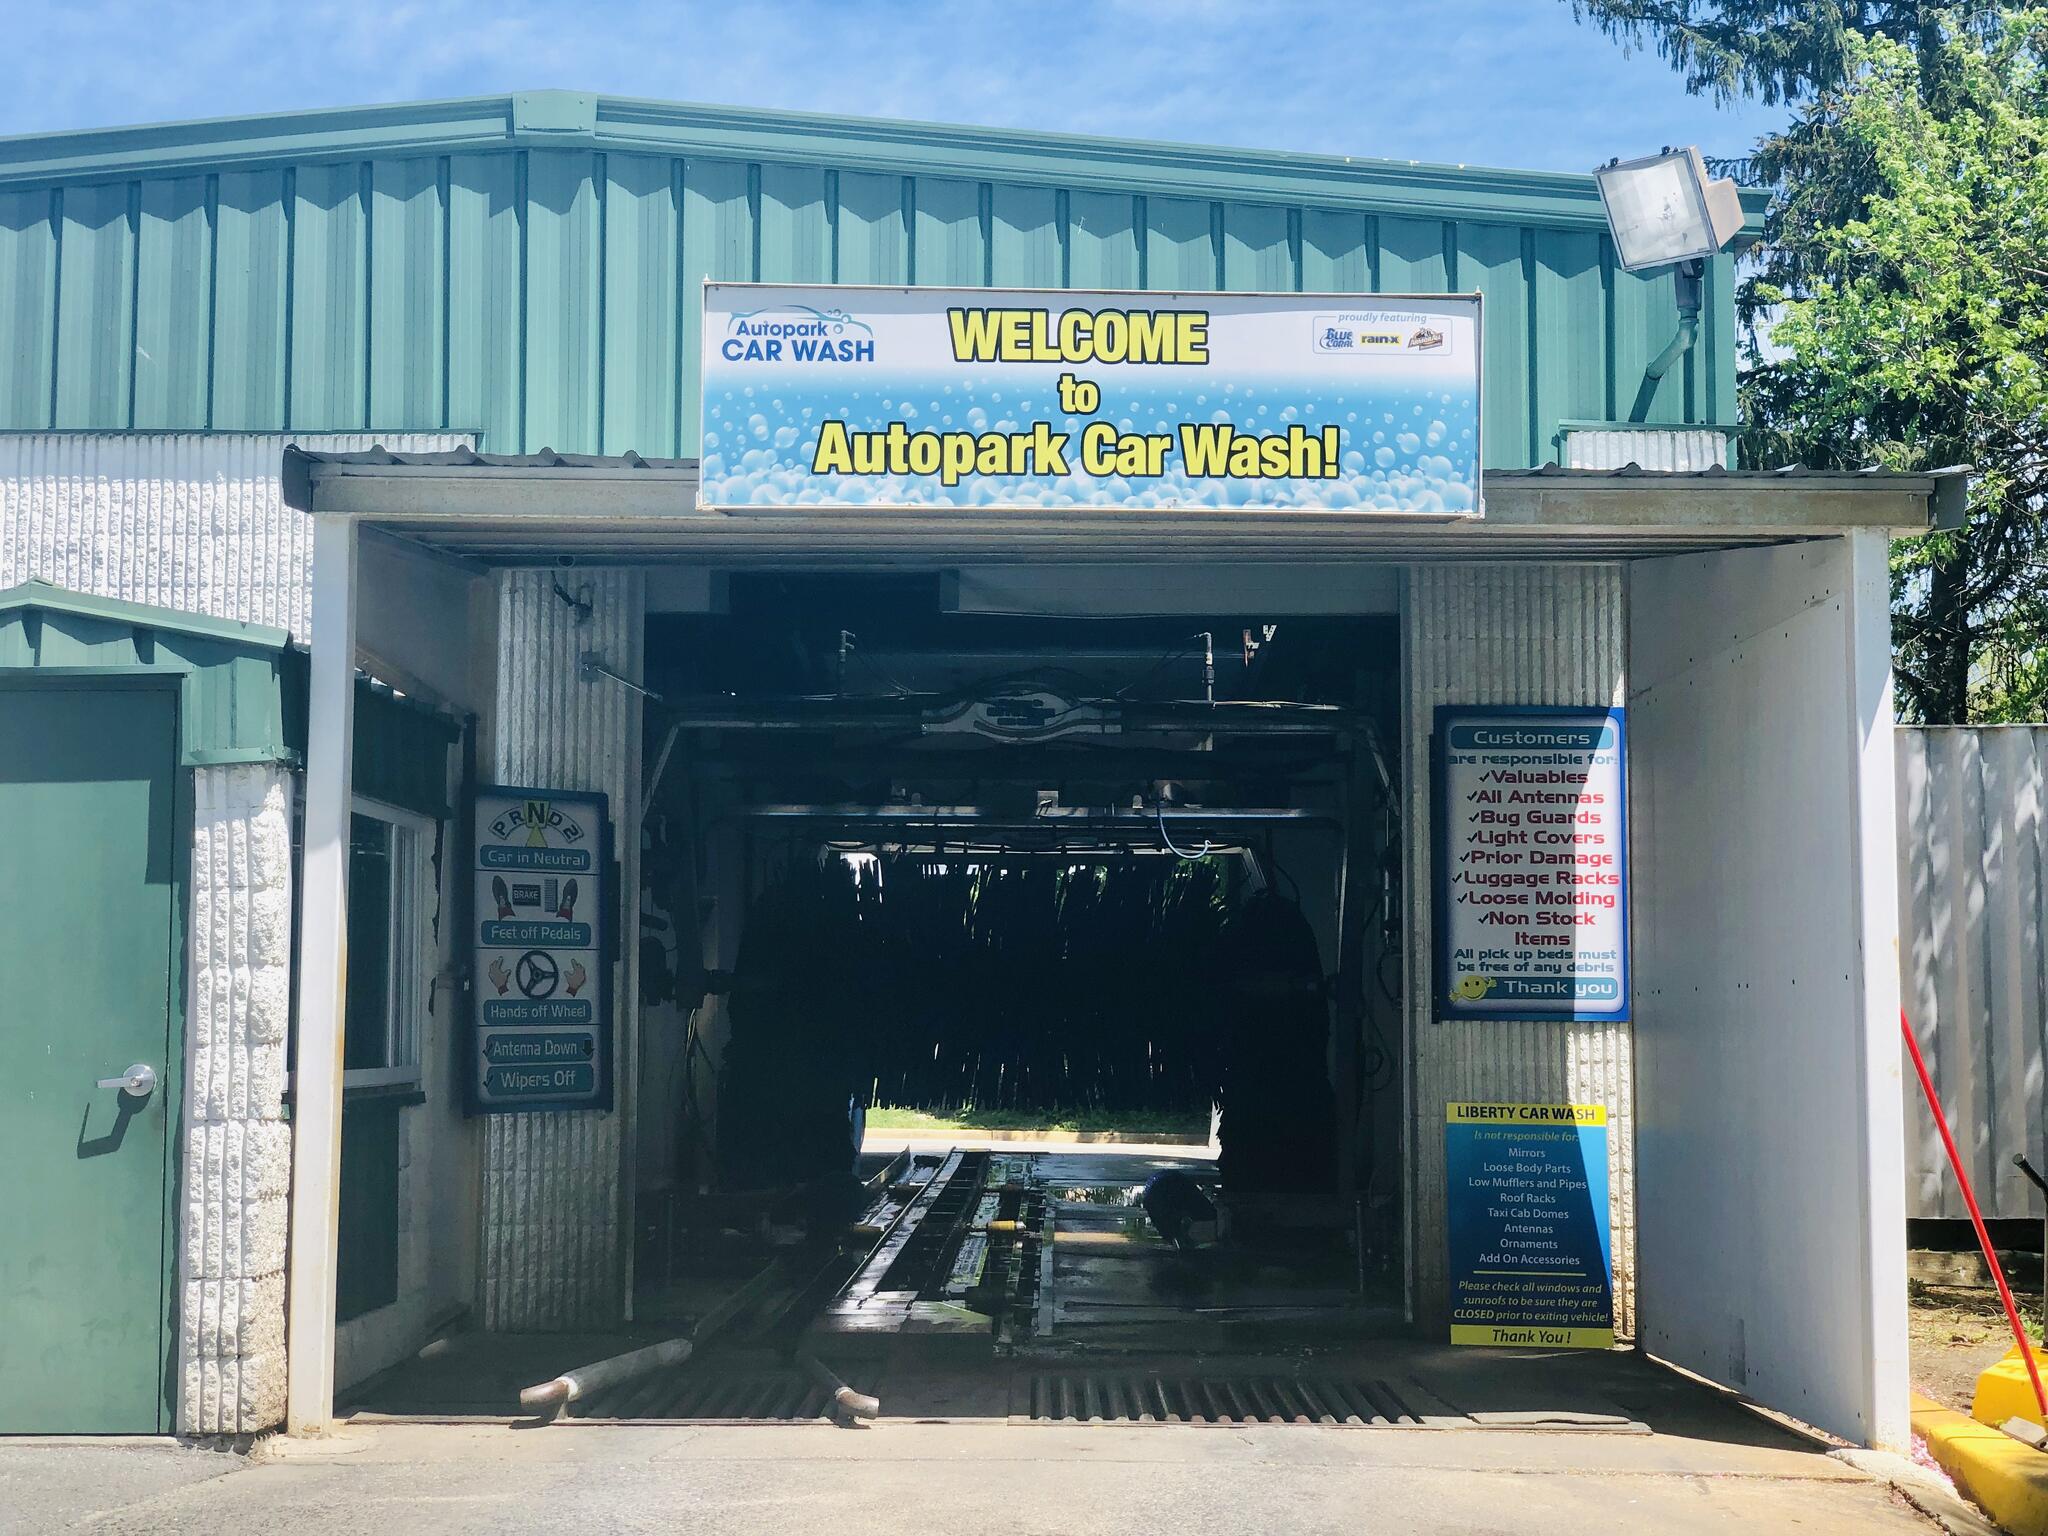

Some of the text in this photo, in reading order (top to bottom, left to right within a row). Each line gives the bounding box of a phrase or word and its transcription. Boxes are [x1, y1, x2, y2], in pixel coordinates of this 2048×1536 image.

[1338, 313, 1427, 324] proudly featuring
[736, 320, 828, 339] Autopark
[947, 307, 1209, 365] WELCOME
[722, 340, 874, 362] CAR WASH
[1058, 373, 1100, 414] to
[812, 420, 1340, 486] Autopark Car Wash!
[1473, 731, 1590, 744] Customers
[1448, 754, 1618, 766] are responsible for:
[1490, 770, 1588, 783] Valuables
[1476, 790, 1604, 803] All Antennas
[1481, 810, 1601, 826] Bug Guards
[1478, 831, 1604, 847] Light Covers
[488, 850, 584, 865] Car in Neutral
[1471, 851, 1612, 867] Prior Damage
[1464, 871, 1619, 887] Luggage Racks
[514, 890, 538, 898] BRAKE
[1469, 891, 1615, 908] Loose Molding
[1489, 912, 1595, 925] Non Stock
[491, 926, 581, 940] Feet off Pedals
[1515, 932, 1570, 945] Items
[1454, 949, 1616, 961] All pick up beds must
[1458, 962, 1613, 974] be free of any debris
[1504, 981, 1612, 996] Thank you
[491, 1006, 585, 1017] Hands off Wheel
[493, 1040, 577, 1056] Antenna Down
[500, 1070, 576, 1091] Wipers Off
[1457, 1106, 1595, 1120] LIBERTY CAR WASH
[1474, 1131, 1579, 1143] Is not responsible for:
[1509, 1148, 1546, 1158] Mirrors
[1484, 1163, 1571, 1174] Loose Body Parts
[1469, 1177, 1587, 1191] Low Mufflers and Pipes
[1501, 1193, 1556, 1203] Roof Racks
[1488, 1208, 1569, 1219] Taxi Cab Domes
[1505, 1224, 1553, 1234] Antennas
[1500, 1239, 1558, 1249] Ornaments
[1480, 1254, 1580, 1265] Add On Accessories
[1459, 1281, 1602, 1294] Please check all windows and
[1464, 1296, 1597, 1309] sunroofs to be sure they are
[1454, 1310, 1608, 1323] CLOSED prior to exiting vehicle!
[1493, 1329, 1535, 1343] Thank
[1539, 1331, 1564, 1344] You
